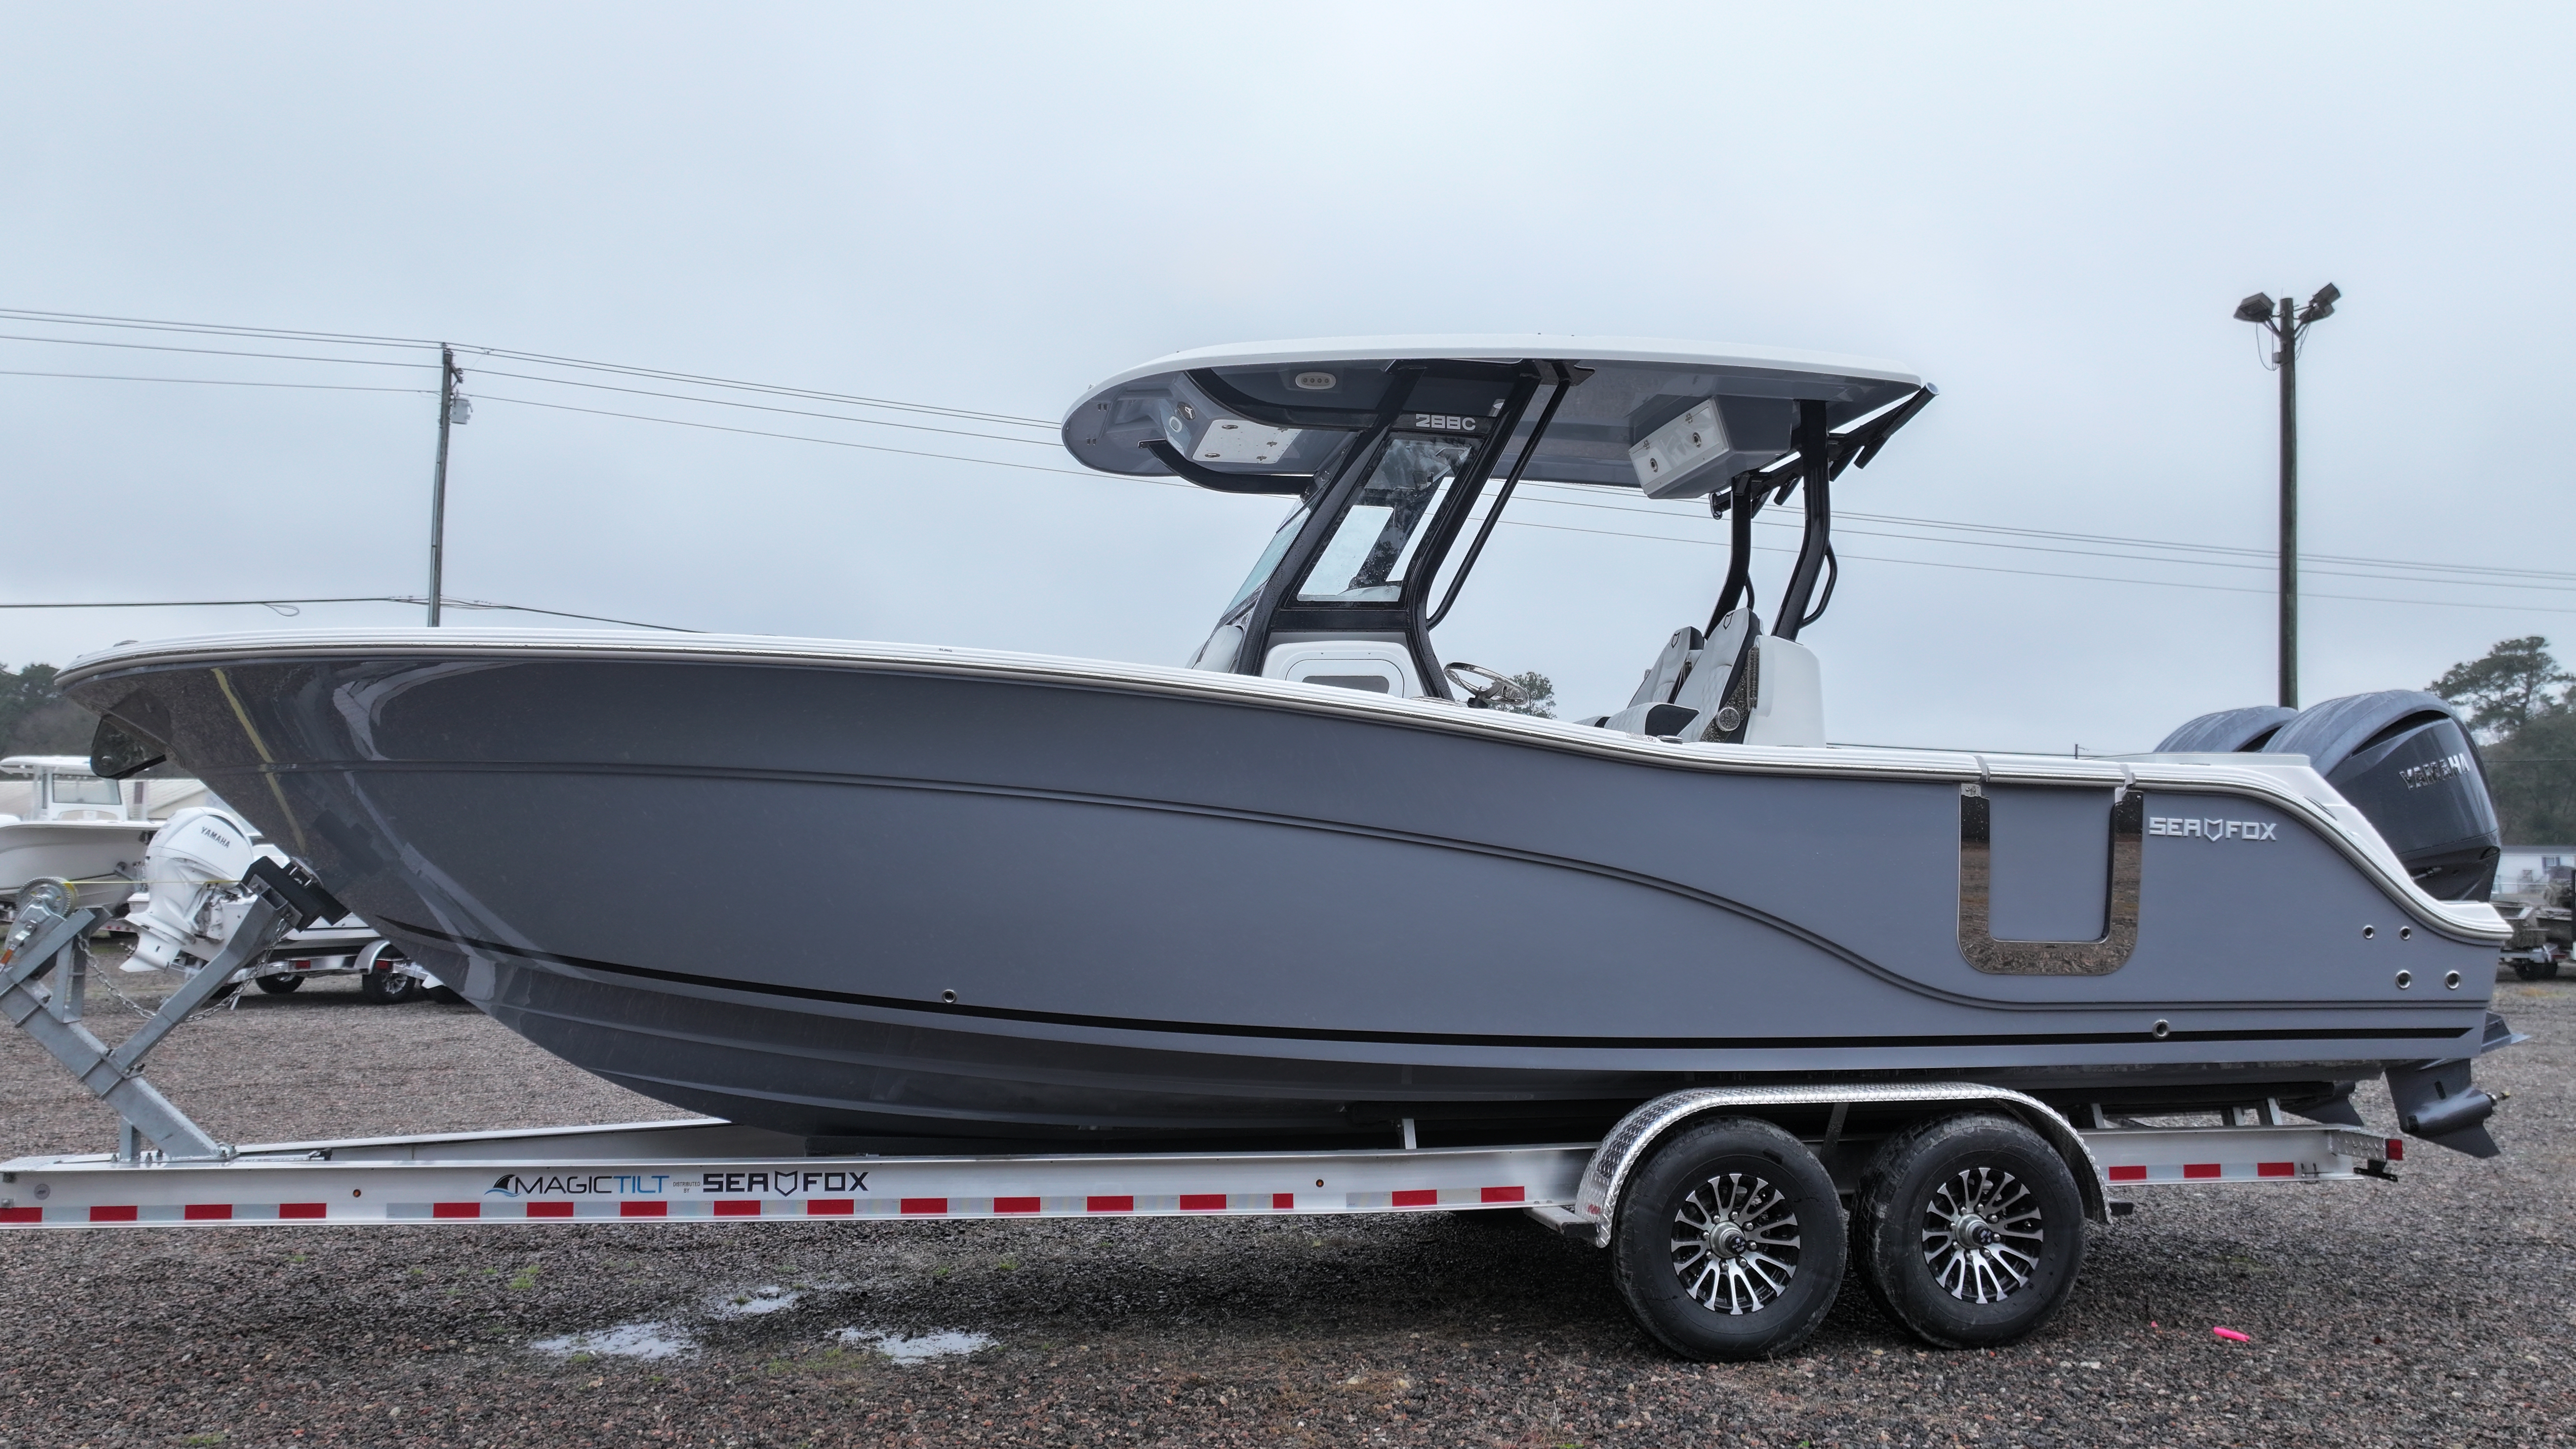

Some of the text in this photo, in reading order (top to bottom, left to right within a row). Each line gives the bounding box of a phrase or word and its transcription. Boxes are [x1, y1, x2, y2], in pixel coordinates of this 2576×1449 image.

[1415, 413, 1476, 431] 288C
[2399, 753, 2470, 791] YAMAHA
[201, 826, 231, 848] YAMAHA
[2149, 817, 2277, 841] SEA FOX
[514, 1175, 670, 1194] MAGICTILT
[703, 1172, 869, 1193] SEA FOX
